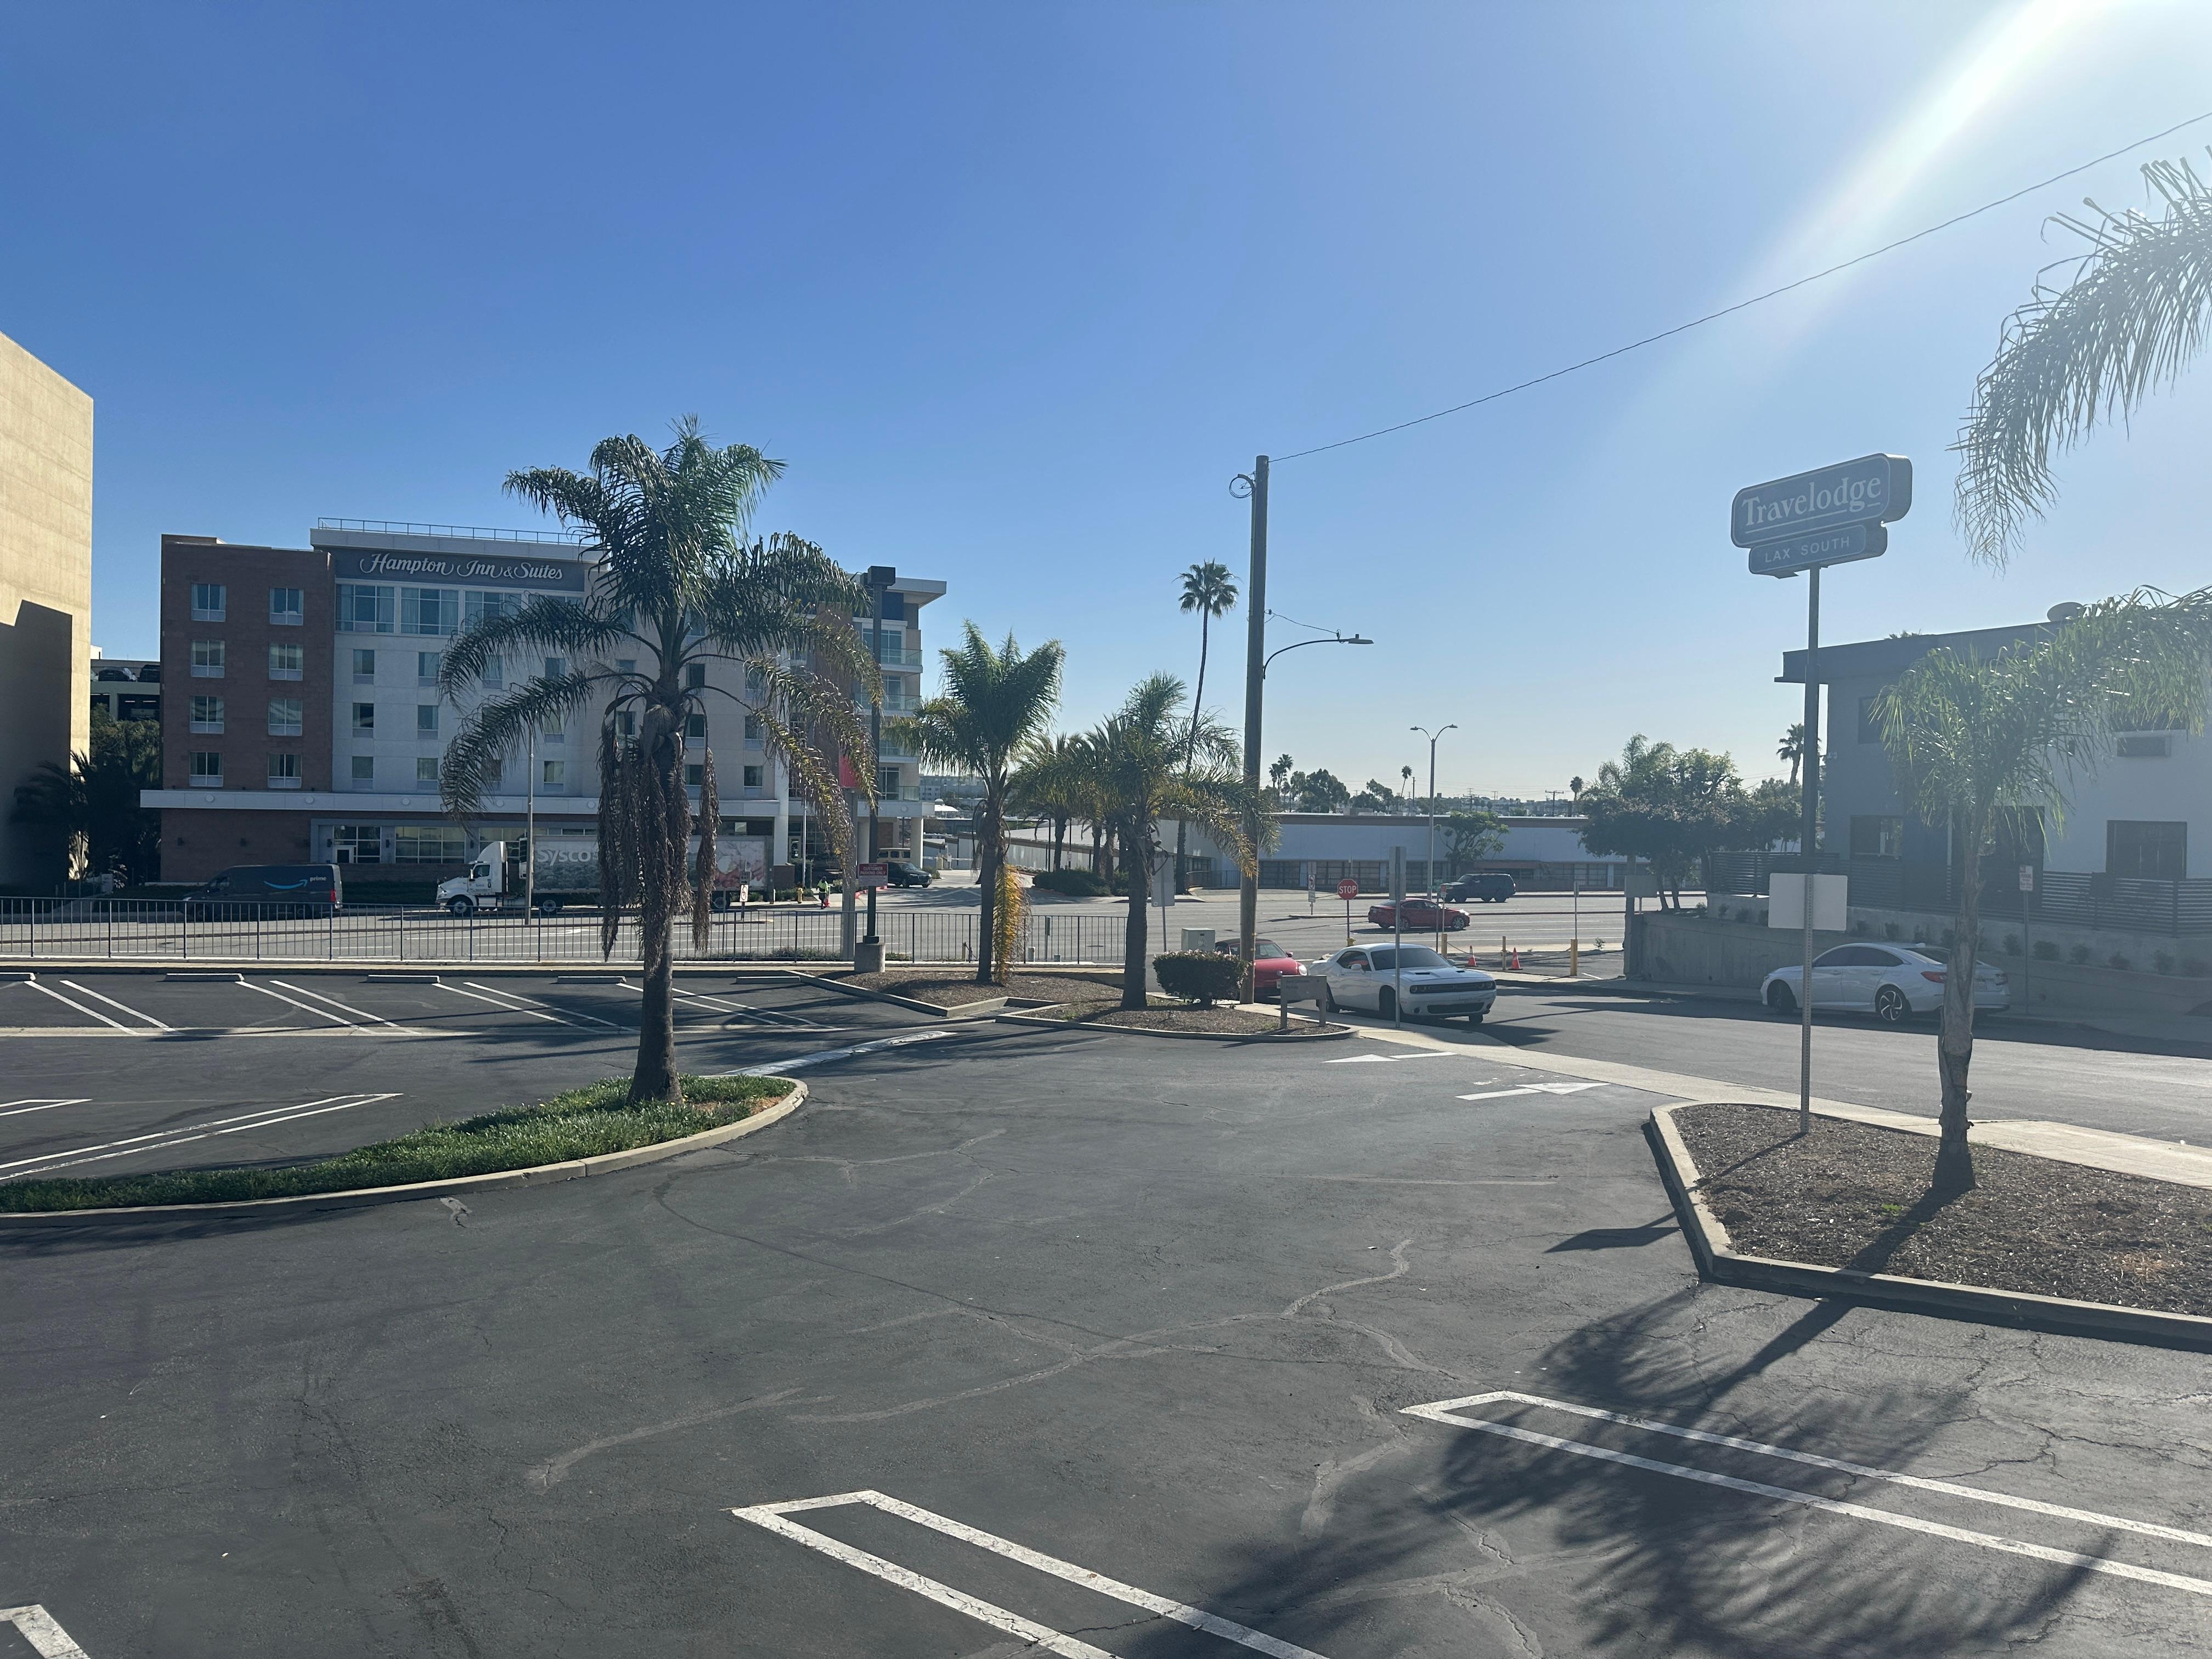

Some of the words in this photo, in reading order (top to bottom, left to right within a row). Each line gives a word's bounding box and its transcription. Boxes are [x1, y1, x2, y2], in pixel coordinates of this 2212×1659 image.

[1741, 477, 1881, 526] Travelodge
[1765, 549, 1790, 563] LAX
[1801, 536, 1850, 556] SOUTH
[360, 553, 454, 575] Hampton
[456, 560, 503, 578] Inn
[514, 562, 562, 579] Suites
[1339, 885, 1357, 894] STOP
